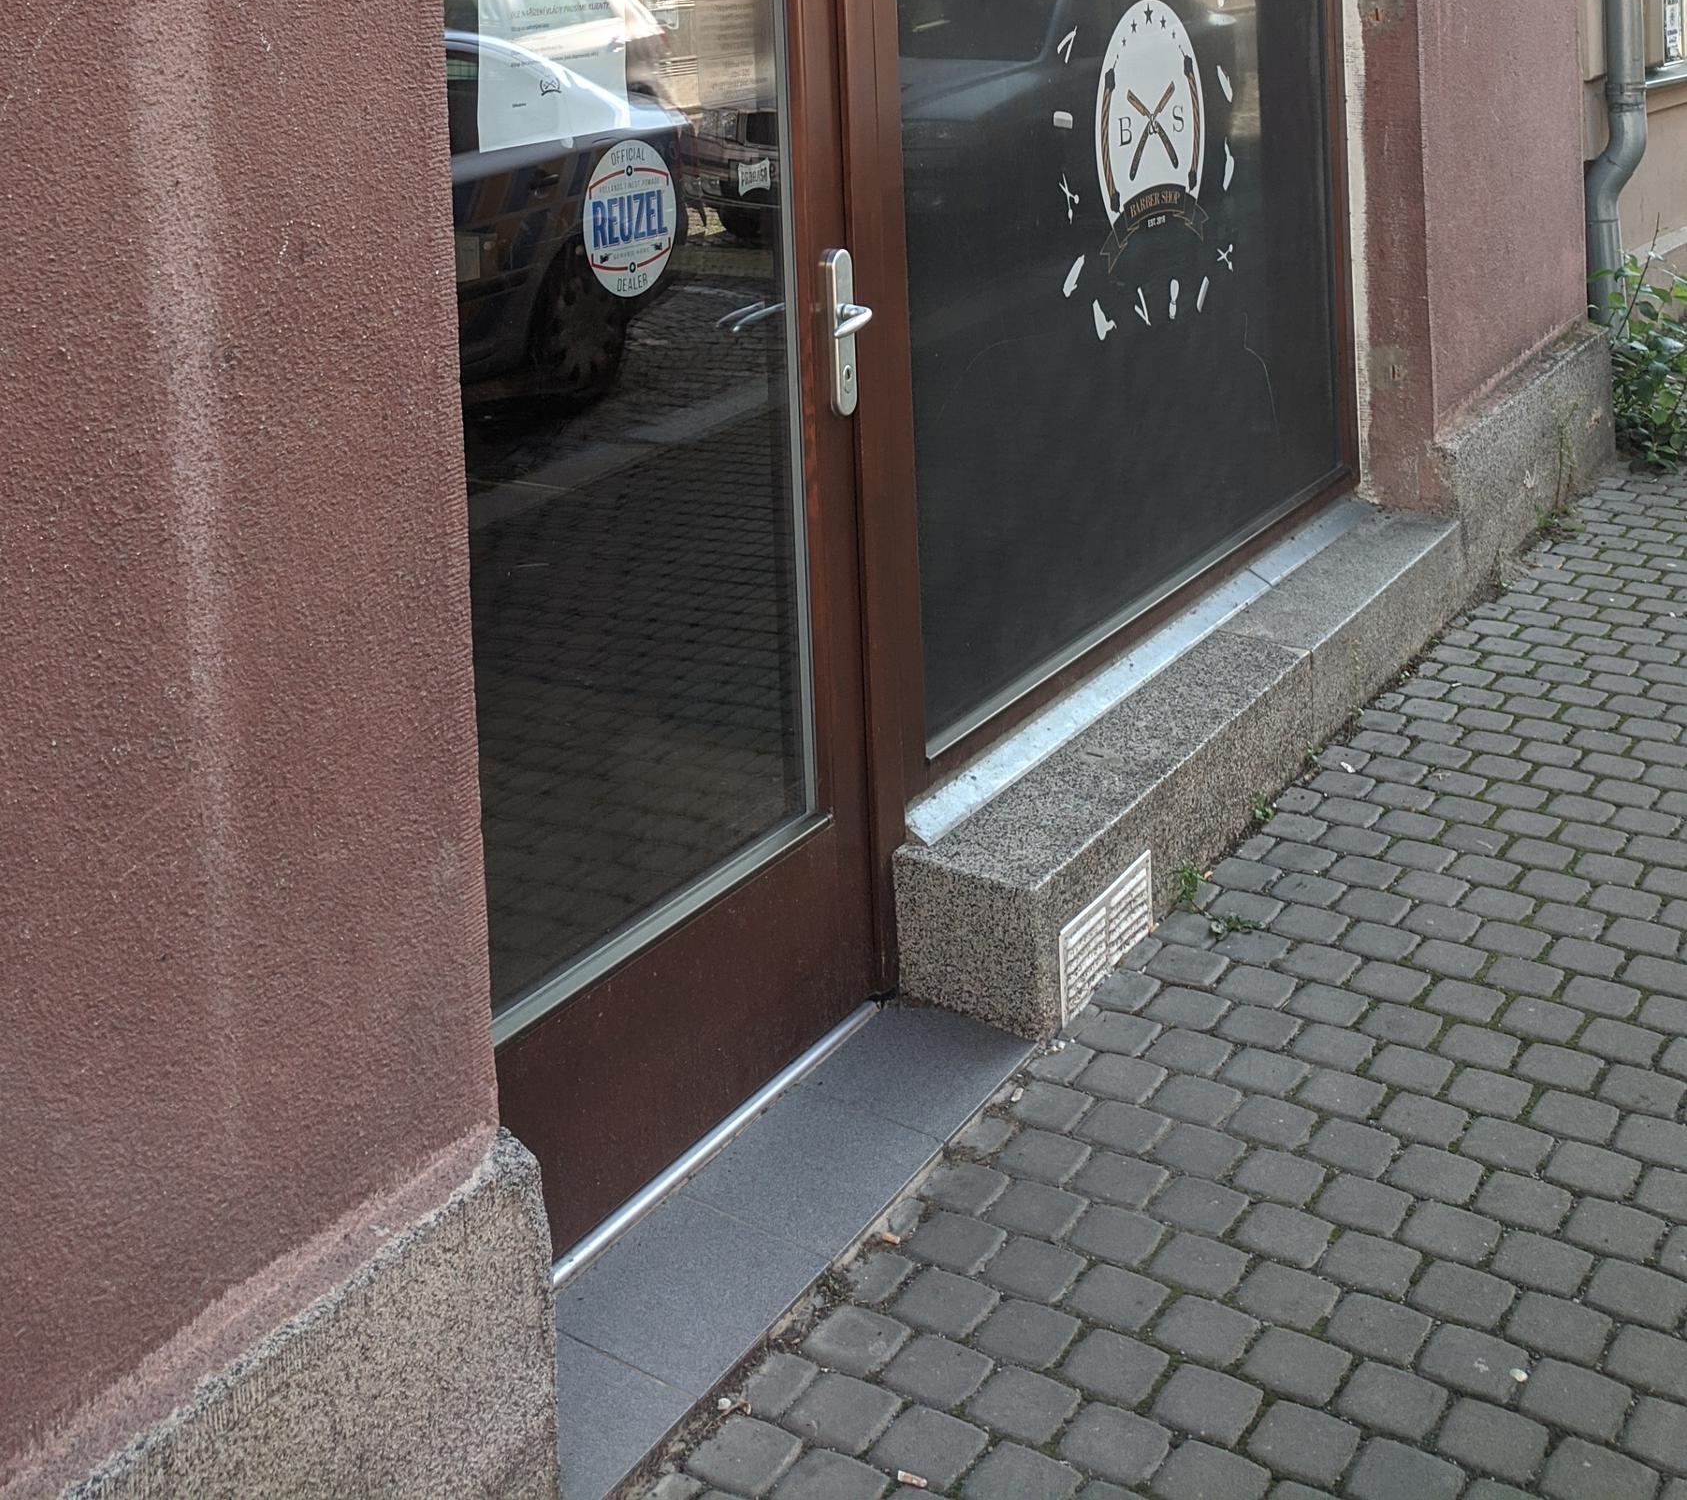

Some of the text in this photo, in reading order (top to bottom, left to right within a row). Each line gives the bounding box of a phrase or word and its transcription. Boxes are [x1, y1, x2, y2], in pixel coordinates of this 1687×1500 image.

[1117, 116, 1133, 147] B
[1172, 104, 1185, 133] S
[610, 147, 646, 167] OFFICIAL
[1129, 190, 1181, 219] BARBER SHOP
[591, 189, 669, 250] REUZEL
[616, 272, 649, 293] DEALER
